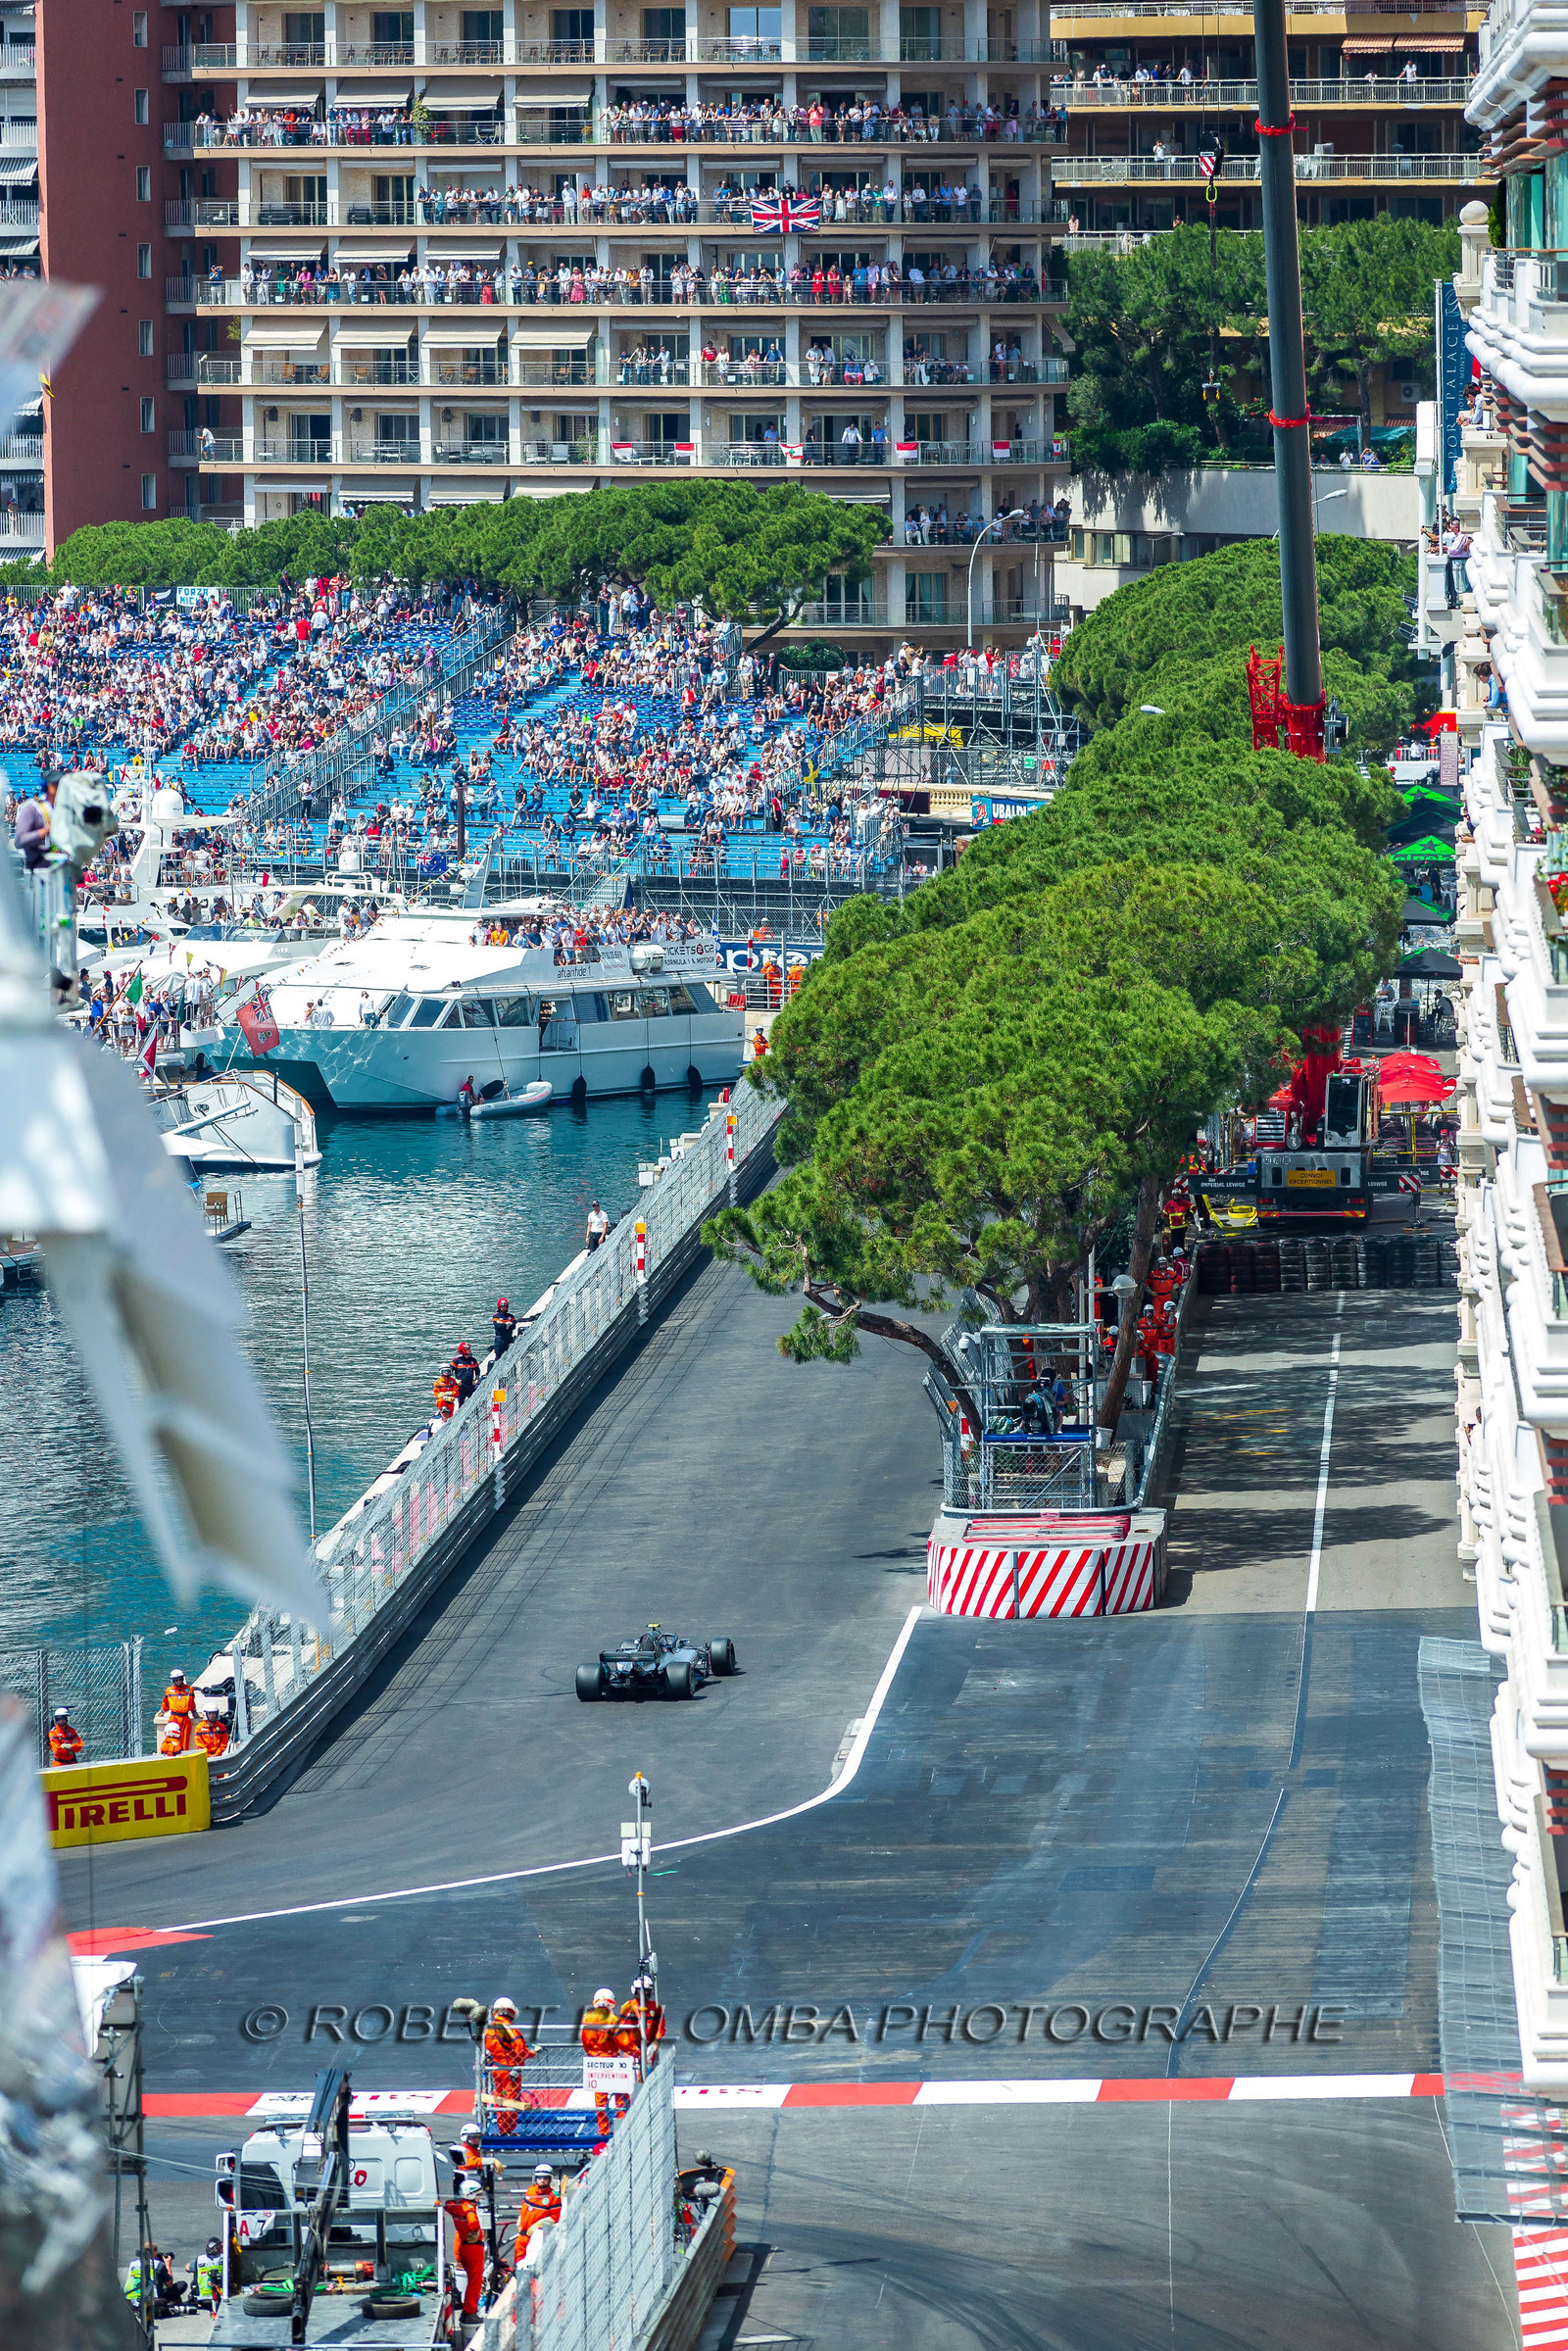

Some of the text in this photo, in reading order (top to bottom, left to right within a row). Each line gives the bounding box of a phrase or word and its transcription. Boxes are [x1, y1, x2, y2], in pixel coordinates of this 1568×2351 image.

[1446, 323, 1459, 459] PORT PALACE
[177, 587, 209, 597] FORZA
[992, 803, 1027, 819] UBALDI
[43, 1776, 188, 1832] PIRELLI
[588, 2080, 598, 2089] 10
